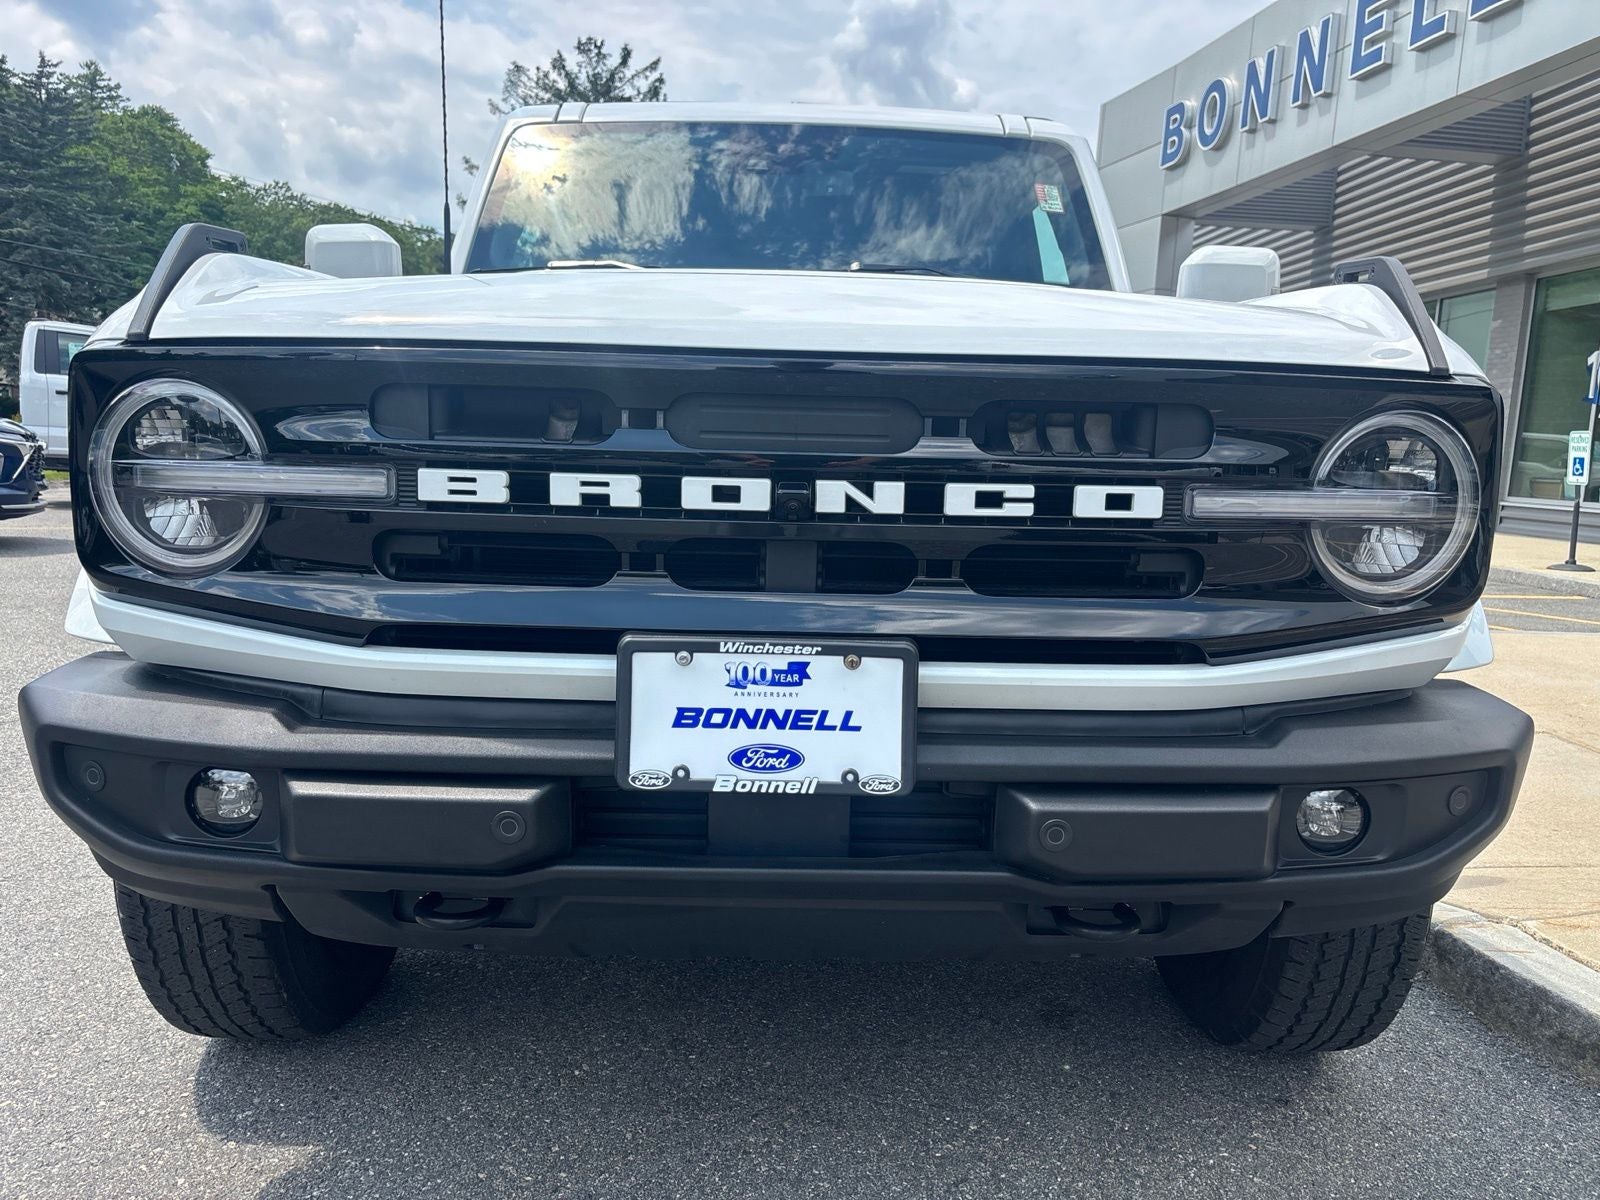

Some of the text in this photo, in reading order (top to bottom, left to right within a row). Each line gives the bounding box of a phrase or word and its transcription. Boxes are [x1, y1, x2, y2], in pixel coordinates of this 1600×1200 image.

[1159, 0, 1522, 169] BONNEL
[417, 467, 1164, 519] BRONCO
[719, 641, 822, 655] Winchester
[724, 661, 800, 686] 100 YEAR
[733, 690, 799, 698] ANNIVERSARY
[671, 706, 862, 732] BONNELL
[741, 751, 789, 770] Ford
[635, 773, 665, 786] Ford
[712, 774, 819, 795] Bonnell
[865, 778, 895, 792] Ford
